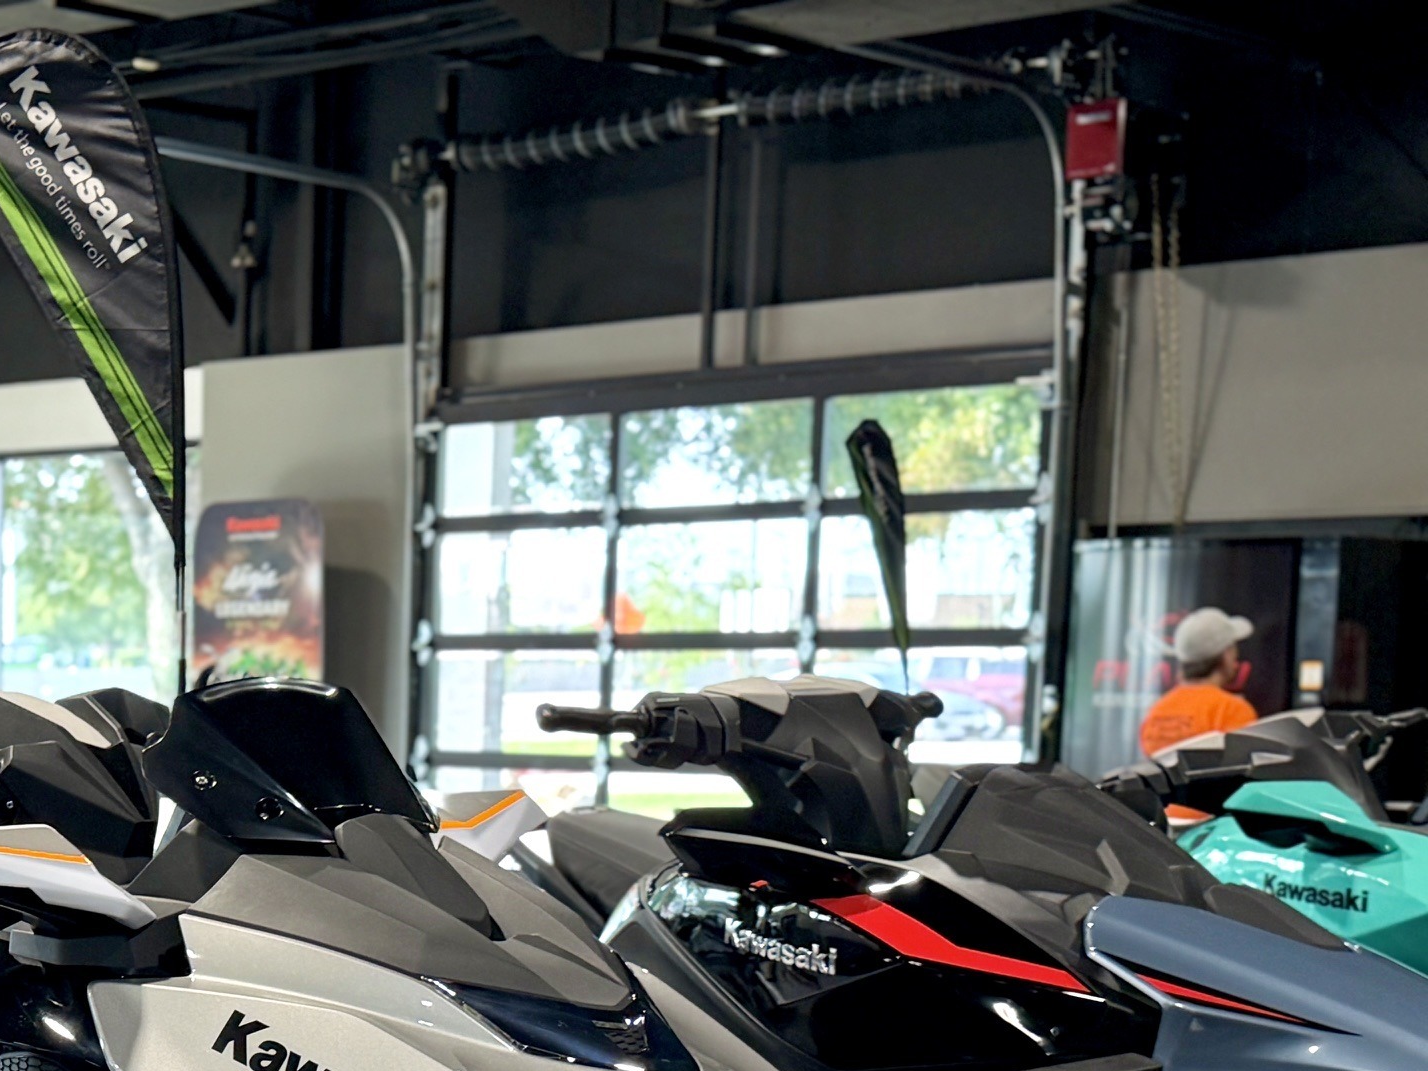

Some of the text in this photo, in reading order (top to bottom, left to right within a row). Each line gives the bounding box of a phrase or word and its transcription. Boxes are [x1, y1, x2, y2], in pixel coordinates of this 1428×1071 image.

[8, 64, 148, 264] Kawasaki
[13, 129, 36, 157] the
[25, 156, 63, 197] good
[54, 196, 87, 241] times
[1263, 872, 1370, 913] Kawasaki
[724, 917, 838, 976] Kawasaki
